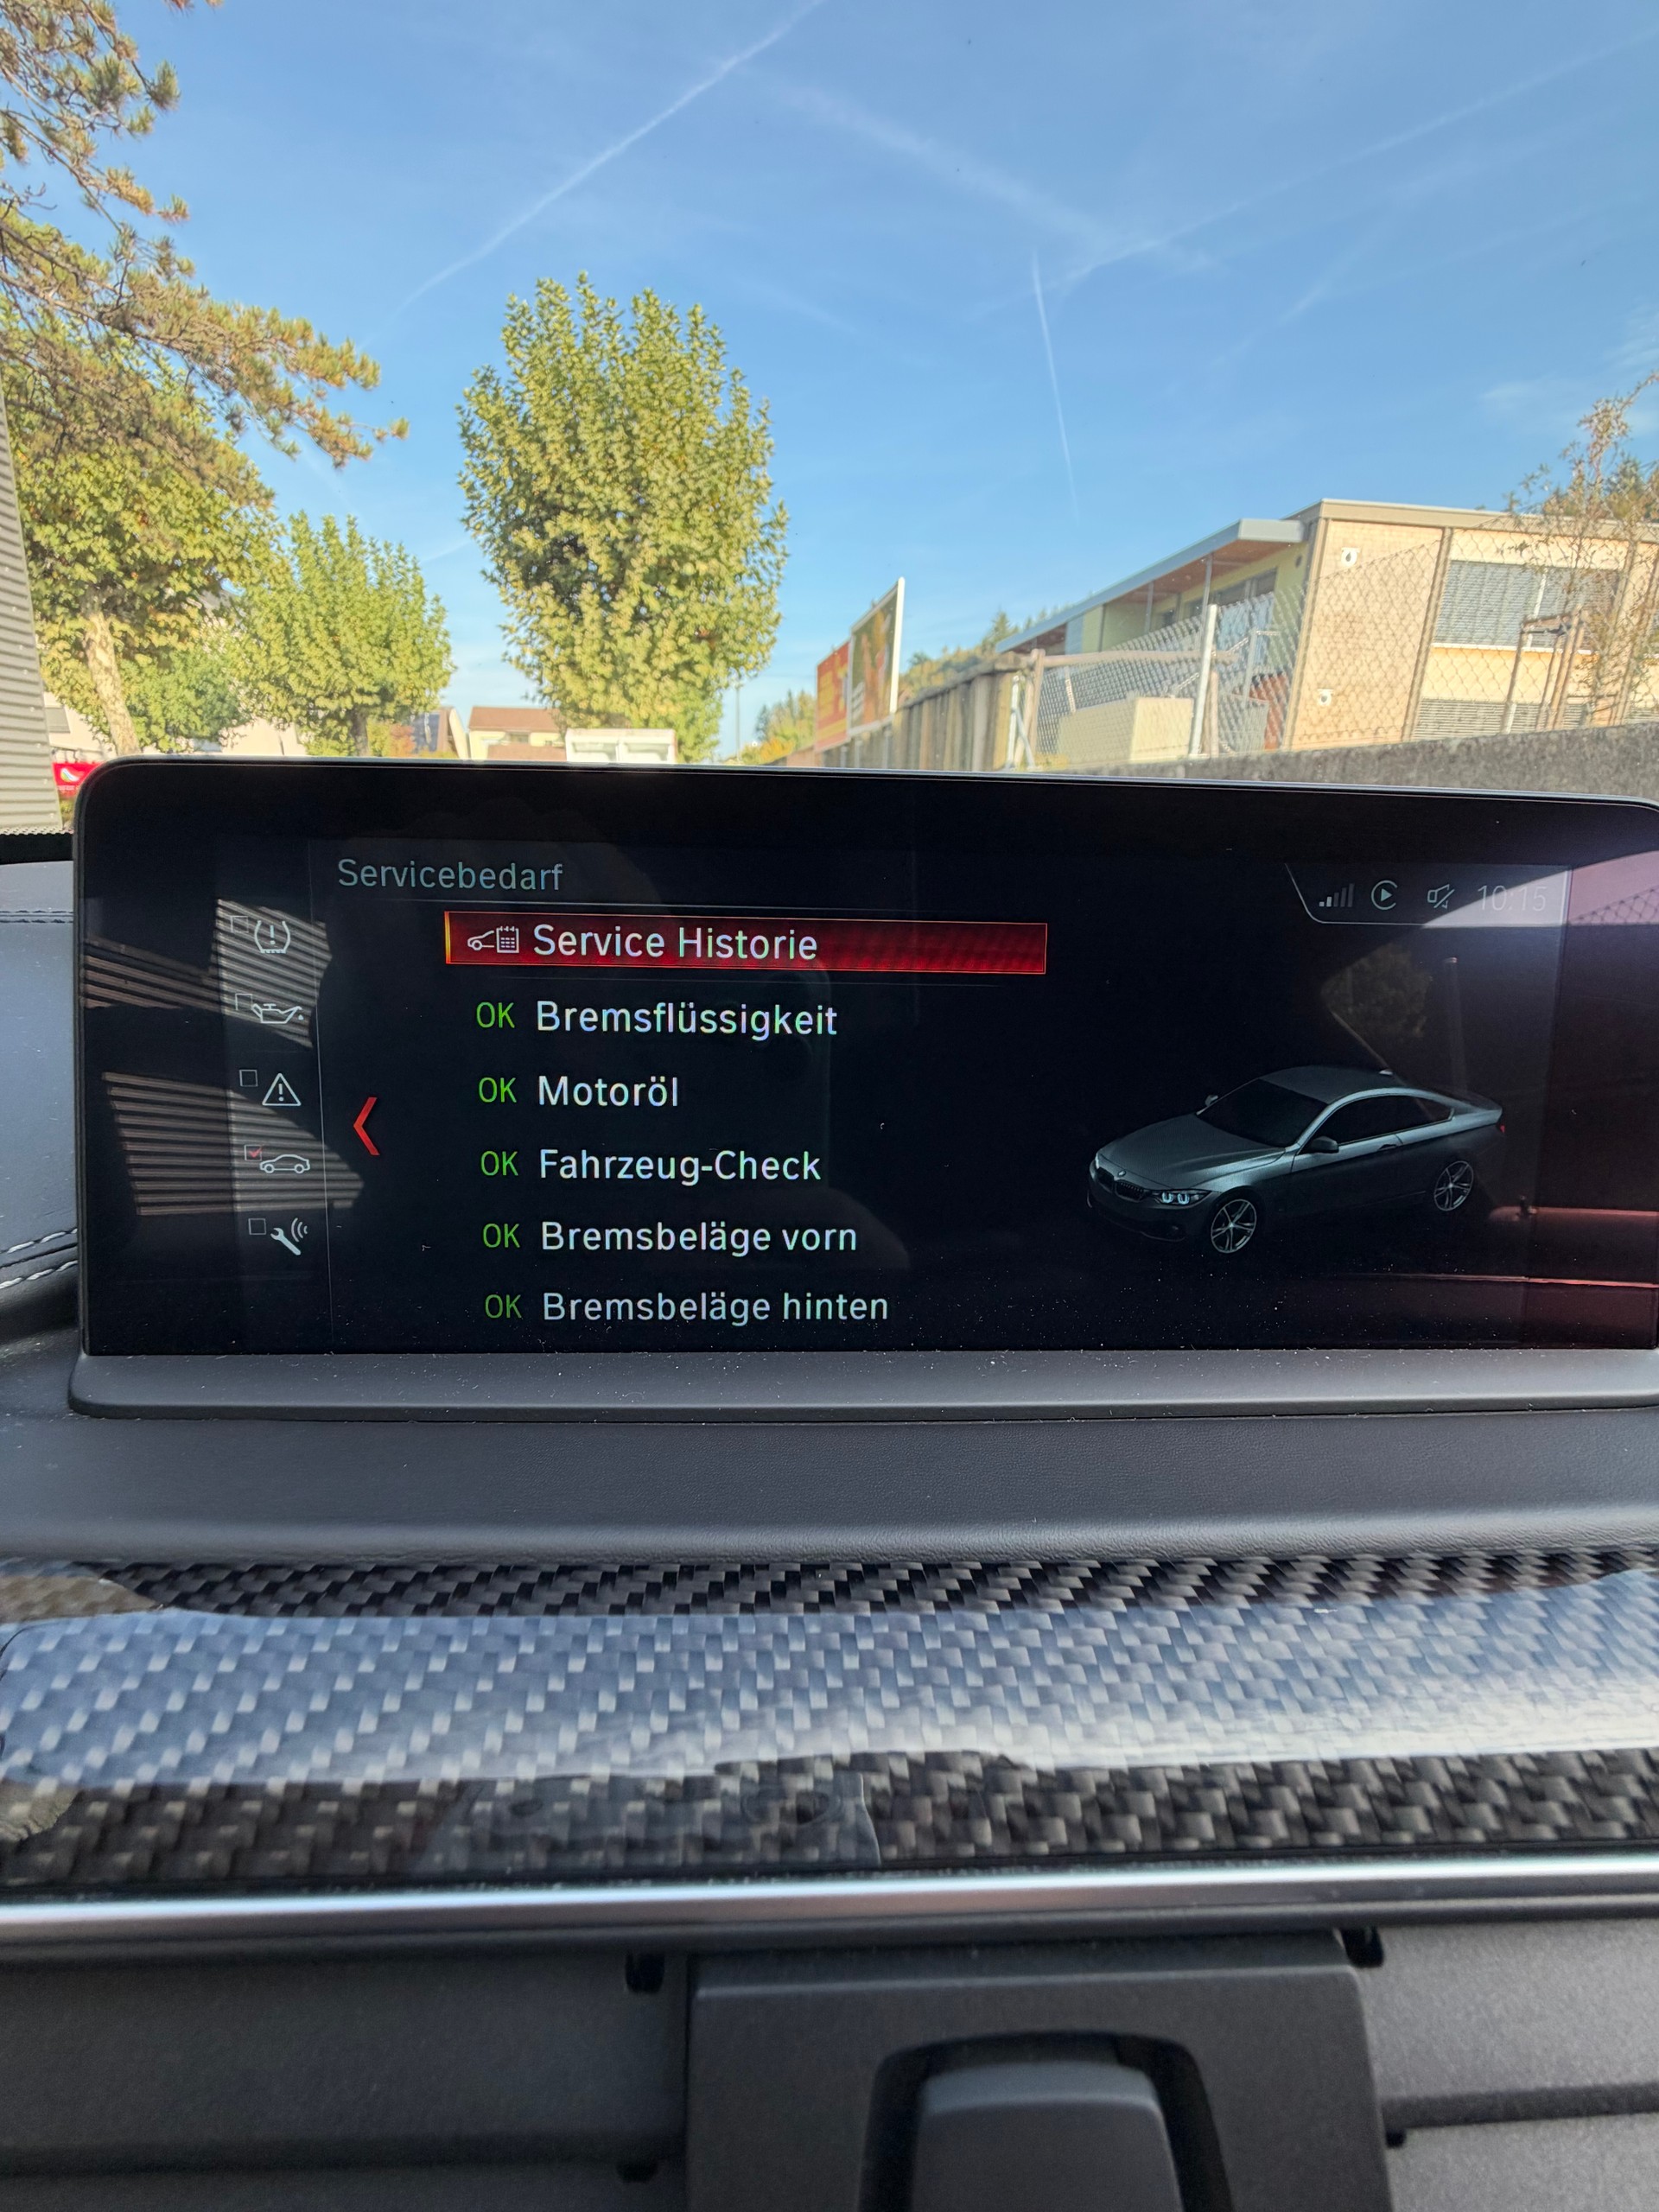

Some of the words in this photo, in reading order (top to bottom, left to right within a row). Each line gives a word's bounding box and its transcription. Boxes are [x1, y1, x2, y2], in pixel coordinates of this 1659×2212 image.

[336, 857, 564, 892] Servicebedarf
[1478, 884, 1548, 912] 10:15
[532, 923, 666, 958] Service
[678, 925, 818, 961] Historie
[476, 1001, 516, 1029] OK
[537, 1001, 838, 1042] Bremsflüssigkeit
[479, 1076, 518, 1104] OK
[538, 1075, 678, 1108] Motoröl
[480, 1150, 519, 1177] OK
[540, 1148, 822, 1187] Fahrzeug-Check
[482, 1222, 521, 1249] OK
[541, 1220, 772, 1258] Bremsbeläge
[781, 1227, 858, 1252] vorn
[484, 1293, 523, 1320] OK
[543, 1291, 772, 1328] Bremsbeläge
[782, 1291, 889, 1321] hinten
